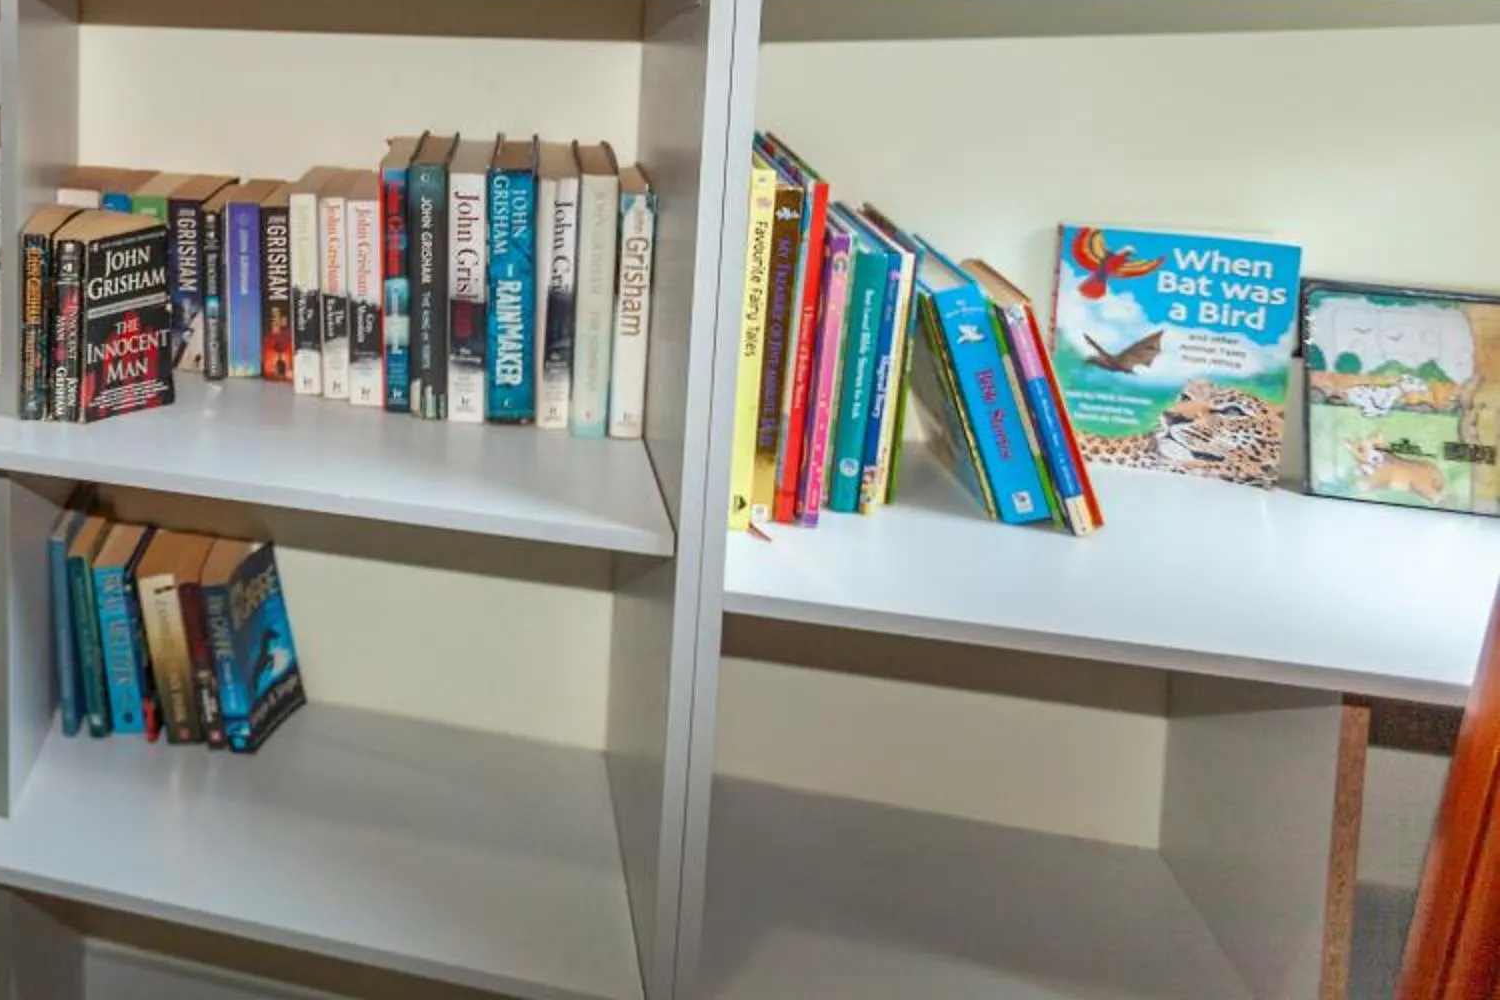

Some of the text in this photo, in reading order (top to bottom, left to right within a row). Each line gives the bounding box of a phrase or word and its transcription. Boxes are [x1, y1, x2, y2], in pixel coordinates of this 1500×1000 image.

[420, 196, 433, 229] JOHN
[454, 190, 480, 243] John
[493, 175, 510, 255] GRISHAM
[511, 188, 528, 238] JOHN
[552, 200, 573, 250] John
[105, 244, 151, 272] JOHN
[177, 218, 196, 292] GRISHAM
[267, 225, 288, 301] GRISHAM
[420, 232, 433, 284] GRISHAM
[1172, 247, 1275, 281] When
[87, 267, 166, 300] GRISHAM
[621, 237, 650, 337] Grisham
[744, 220, 767, 357] Favourite Fairy Tales
[1156, 271, 1287, 305] Bat was
[115, 319, 140, 334] THE
[495, 279, 523, 386] RAINMAKER
[1169, 298, 1267, 331] a Bird
[87, 328, 171, 364] INNOCENT
[105, 357, 148, 384] MAN
[55, 366, 68, 416] GRISHAM
[66, 377, 79, 407] JOHN
